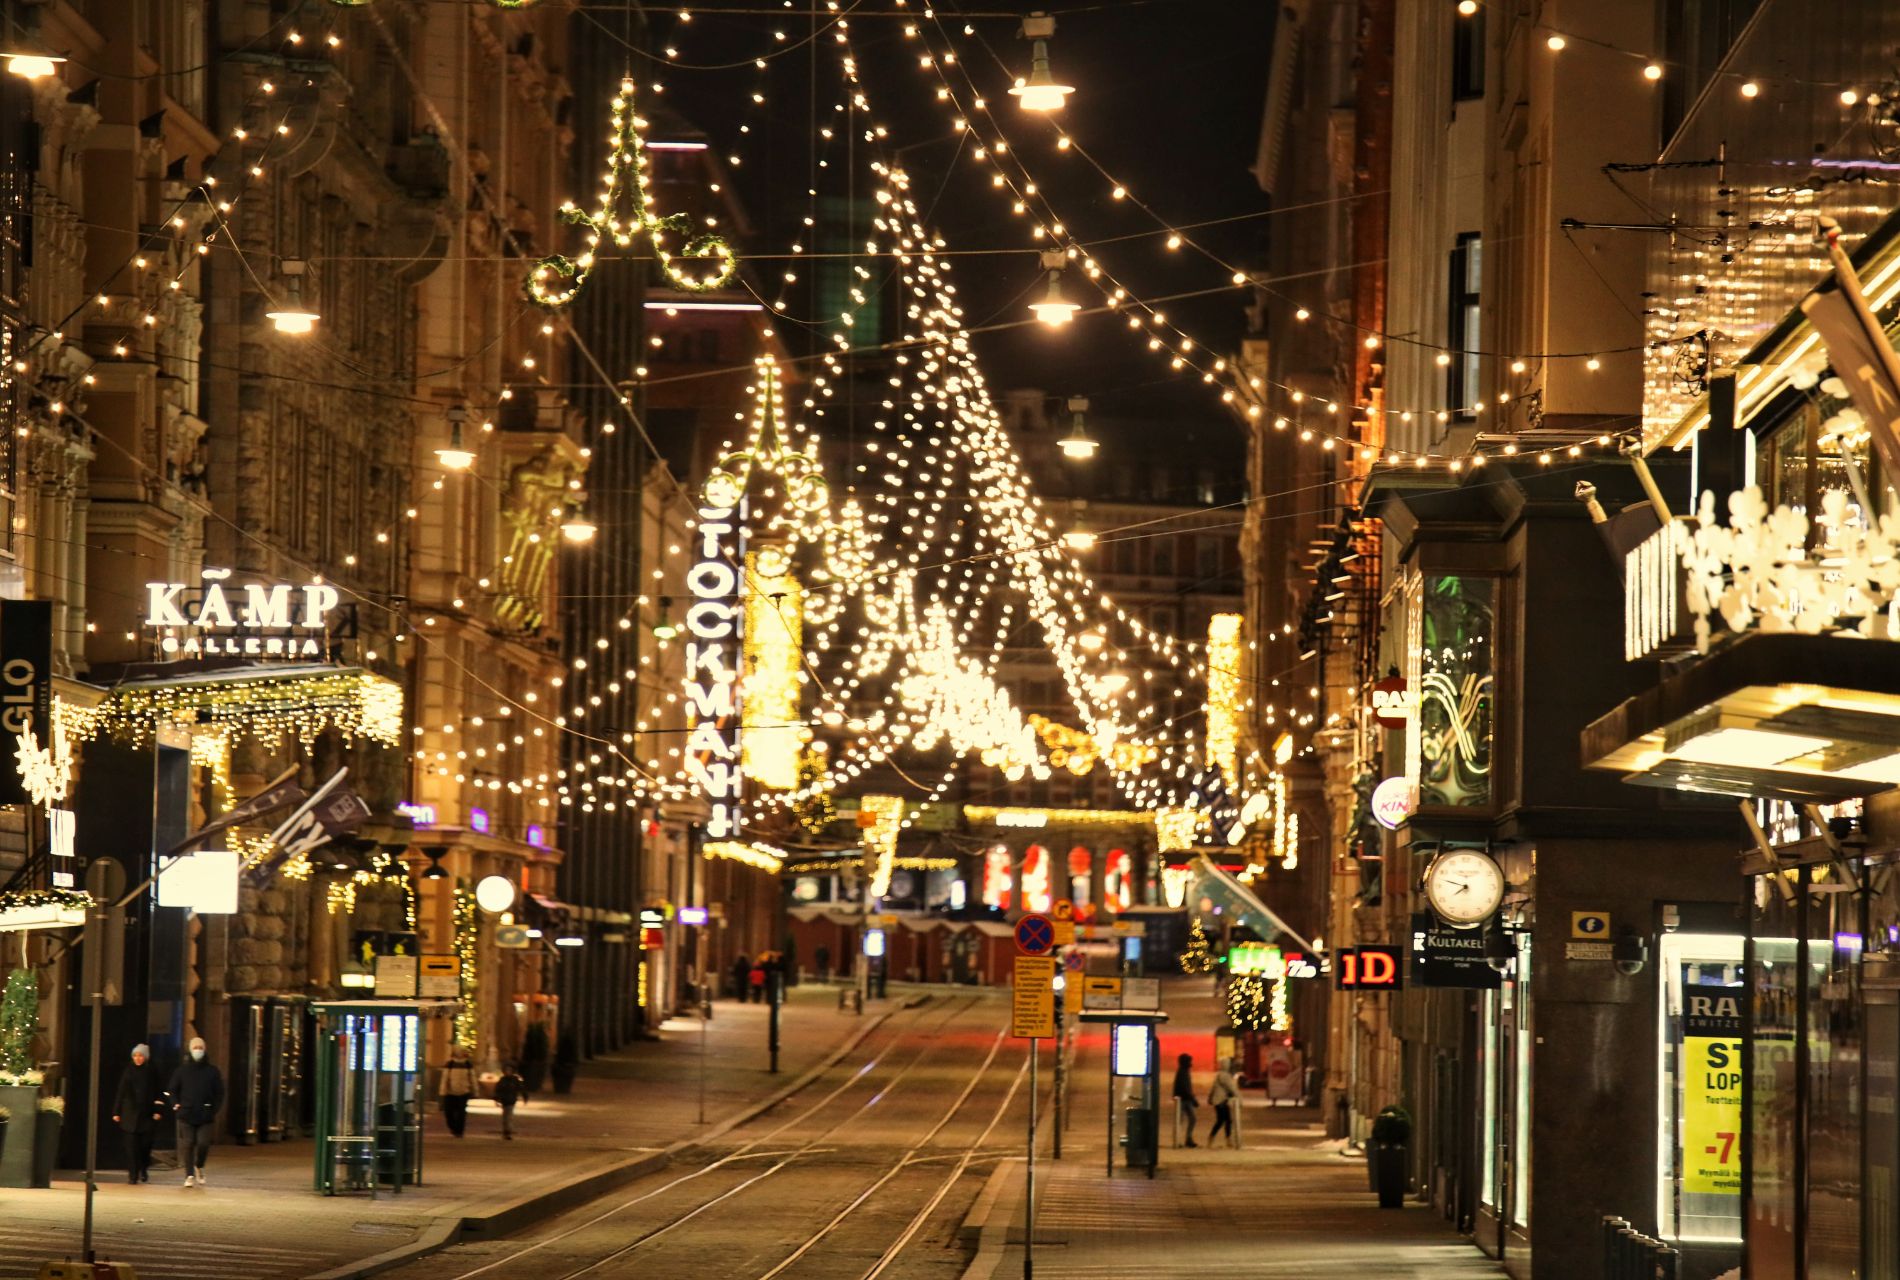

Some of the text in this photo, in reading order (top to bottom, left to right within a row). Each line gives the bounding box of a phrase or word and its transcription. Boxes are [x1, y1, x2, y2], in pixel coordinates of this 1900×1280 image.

[162, 637, 319, 655] GALLERIA
[2, 658, 35, 733] GLO
[1690, 996, 1743, 1017] RA
[1705, 1132, 1741, 1164] -7
